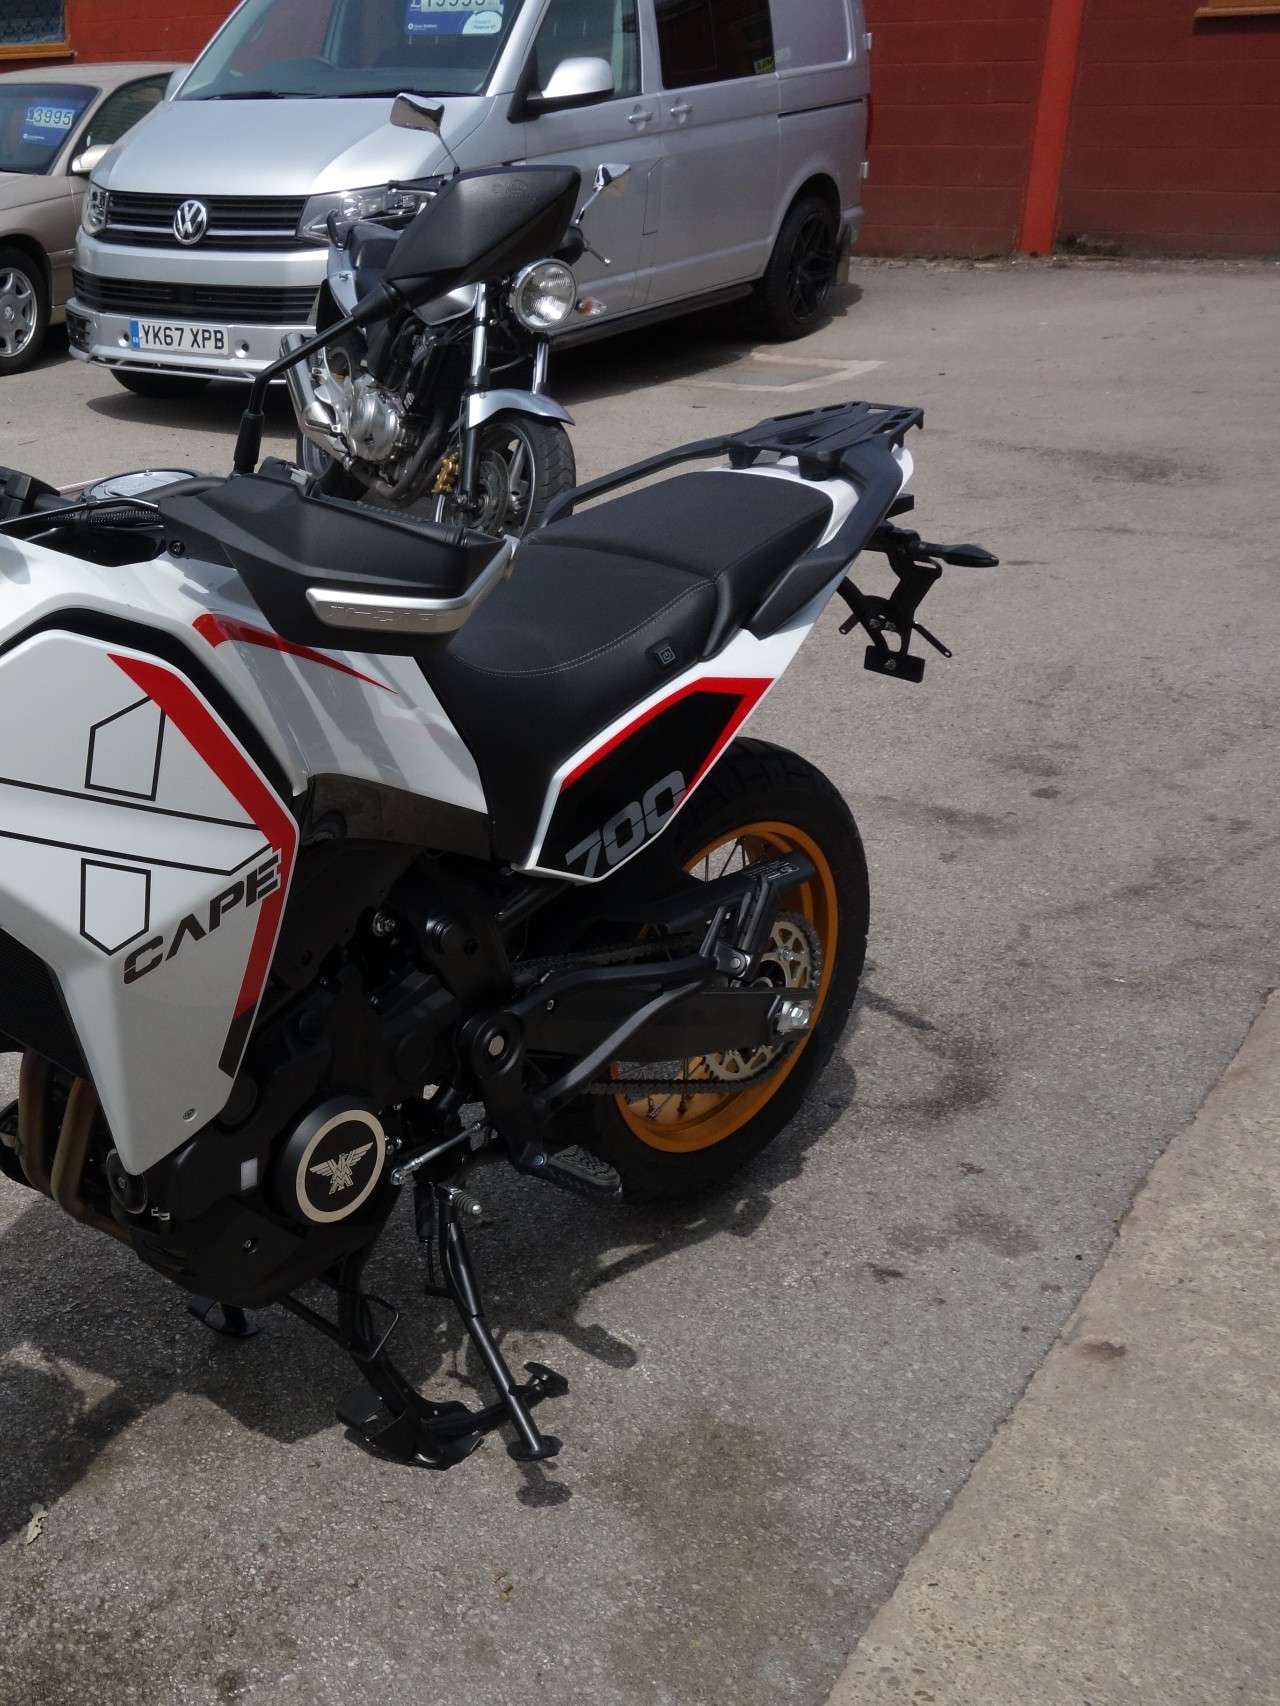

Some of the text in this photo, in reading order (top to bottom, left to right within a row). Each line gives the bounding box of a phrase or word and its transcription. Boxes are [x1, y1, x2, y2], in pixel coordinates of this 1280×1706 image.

[142, 324, 225, 350] YK67 XPB
[564, 770, 687, 878] 700
[123, 853, 280, 985] CAPE
